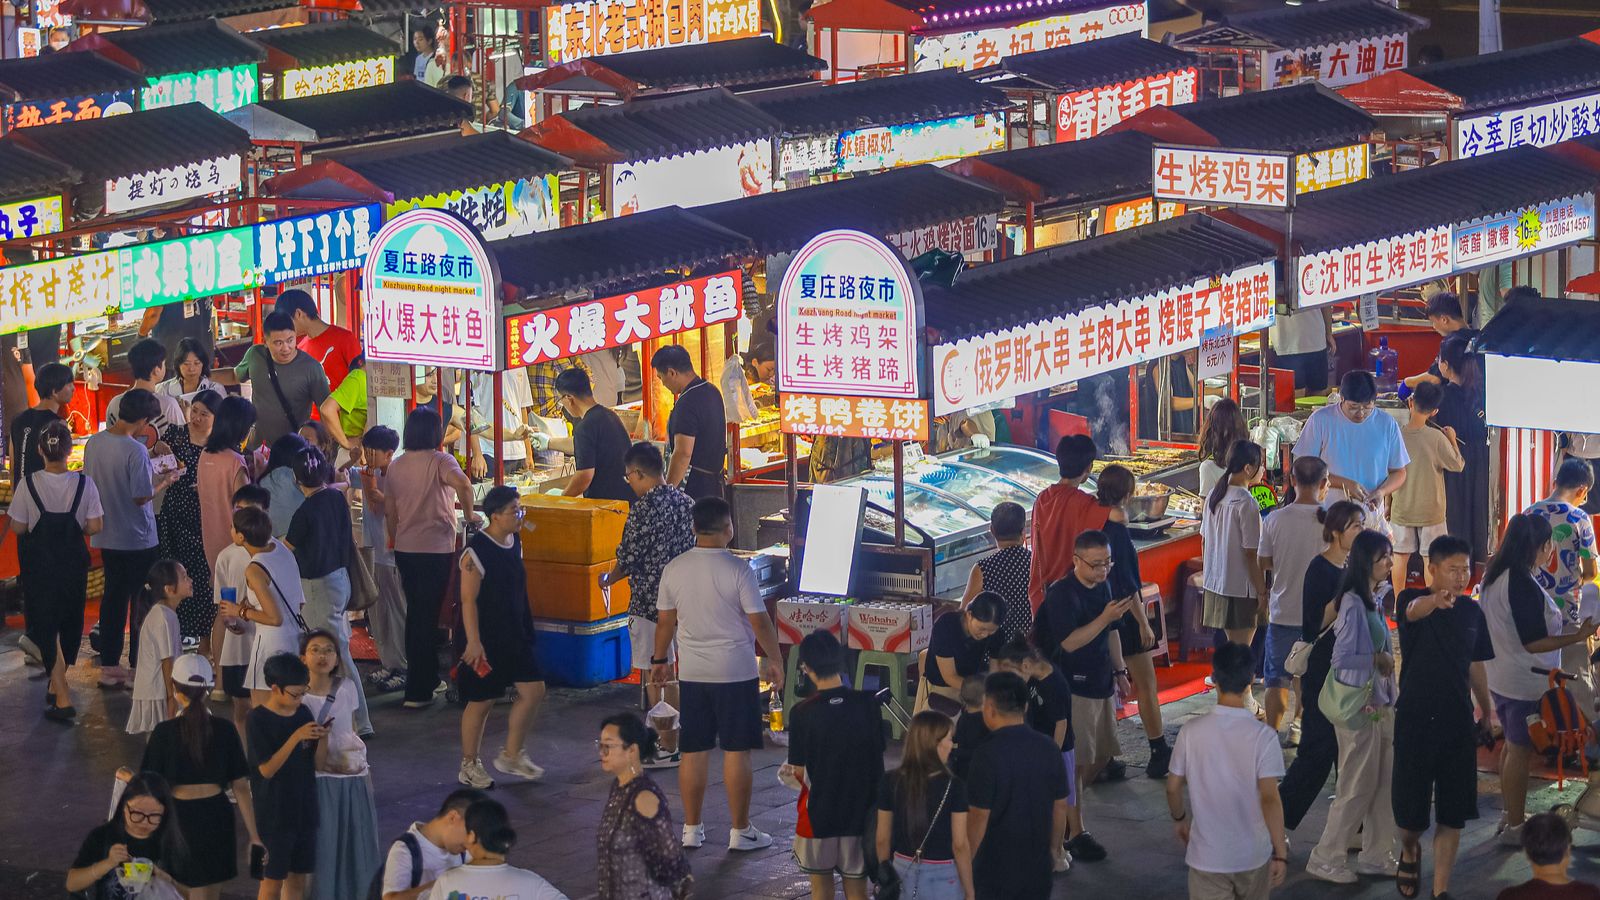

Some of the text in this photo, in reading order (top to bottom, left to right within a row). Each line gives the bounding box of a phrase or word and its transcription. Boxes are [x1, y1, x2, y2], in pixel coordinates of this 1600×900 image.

[1157, 153, 1286, 203] 生烤鸡架
[384, 249, 473, 279] 夏庄路夜市
[1320, 232, 1449, 295] 沈阳生烤鸡架
[0, 255, 114, 318] 榨甘蔗汁
[383, 281, 476, 295] Xiazhuang Road night market
[800, 273, 896, 303] 夏庄路夜市
[374, 299, 485, 347] 火爆大鱿鱼
[522, 275, 739, 364] 火爆大鱿鱼
[835, 308, 852, 317] Road
[873, 310, 897, 320] market
[796, 321, 898, 350] 生烤鸡架
[974, 326, 1070, 396] 俄罗斯大串
[1079, 304, 1151, 367] 羊肉大串
[1158, 287, 1211, 347] 烤腰子
[1218, 272, 1269, 328] 烤猪蹄
[796, 353, 899, 382] 生烤猪蹄
[1206, 350, 1227, 368] 5元/个
[784, 394, 924, 430] 烤鸭卷饼
[789, 608, 829, 623] 娃哈哈
[858, 612, 899, 625] Wahaha
